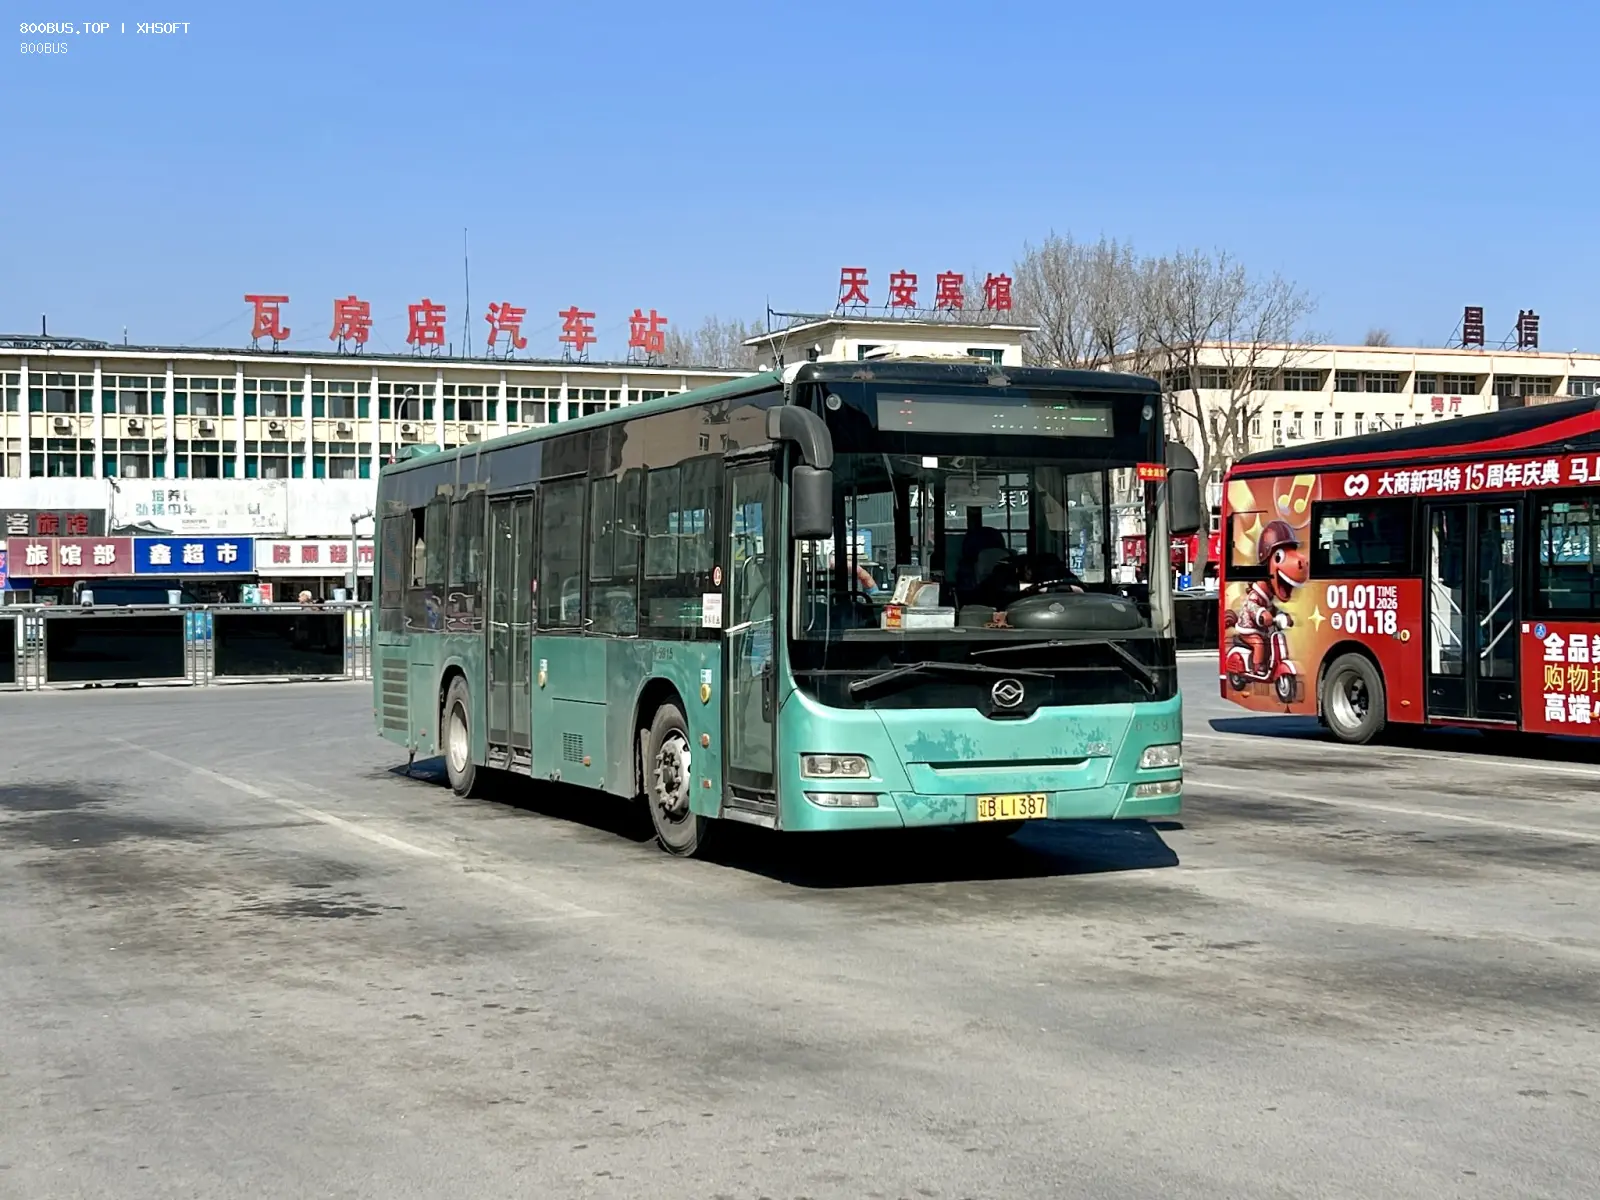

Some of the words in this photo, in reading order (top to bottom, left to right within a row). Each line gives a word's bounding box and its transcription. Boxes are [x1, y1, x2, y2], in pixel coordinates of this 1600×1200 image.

[840, 267, 1012, 311] 天安宾馆
[244, 295, 668, 353] 瓦房店汽车站
[1463, 306, 1540, 349] 昌信
[1377, 459, 1560, 496] 大商新玛特15周年庆典
[25, 544, 116, 566] 旅馆部
[149, 543, 239, 565] 鑫超市
[1326, 585, 1375, 609] 01.01
[1376, 585, 1398, 598] TIME
[1376, 597, 1398, 610] 2026
[1345, 609, 1397, 635] 01.18
[1543, 692, 1600, 723] 高端
